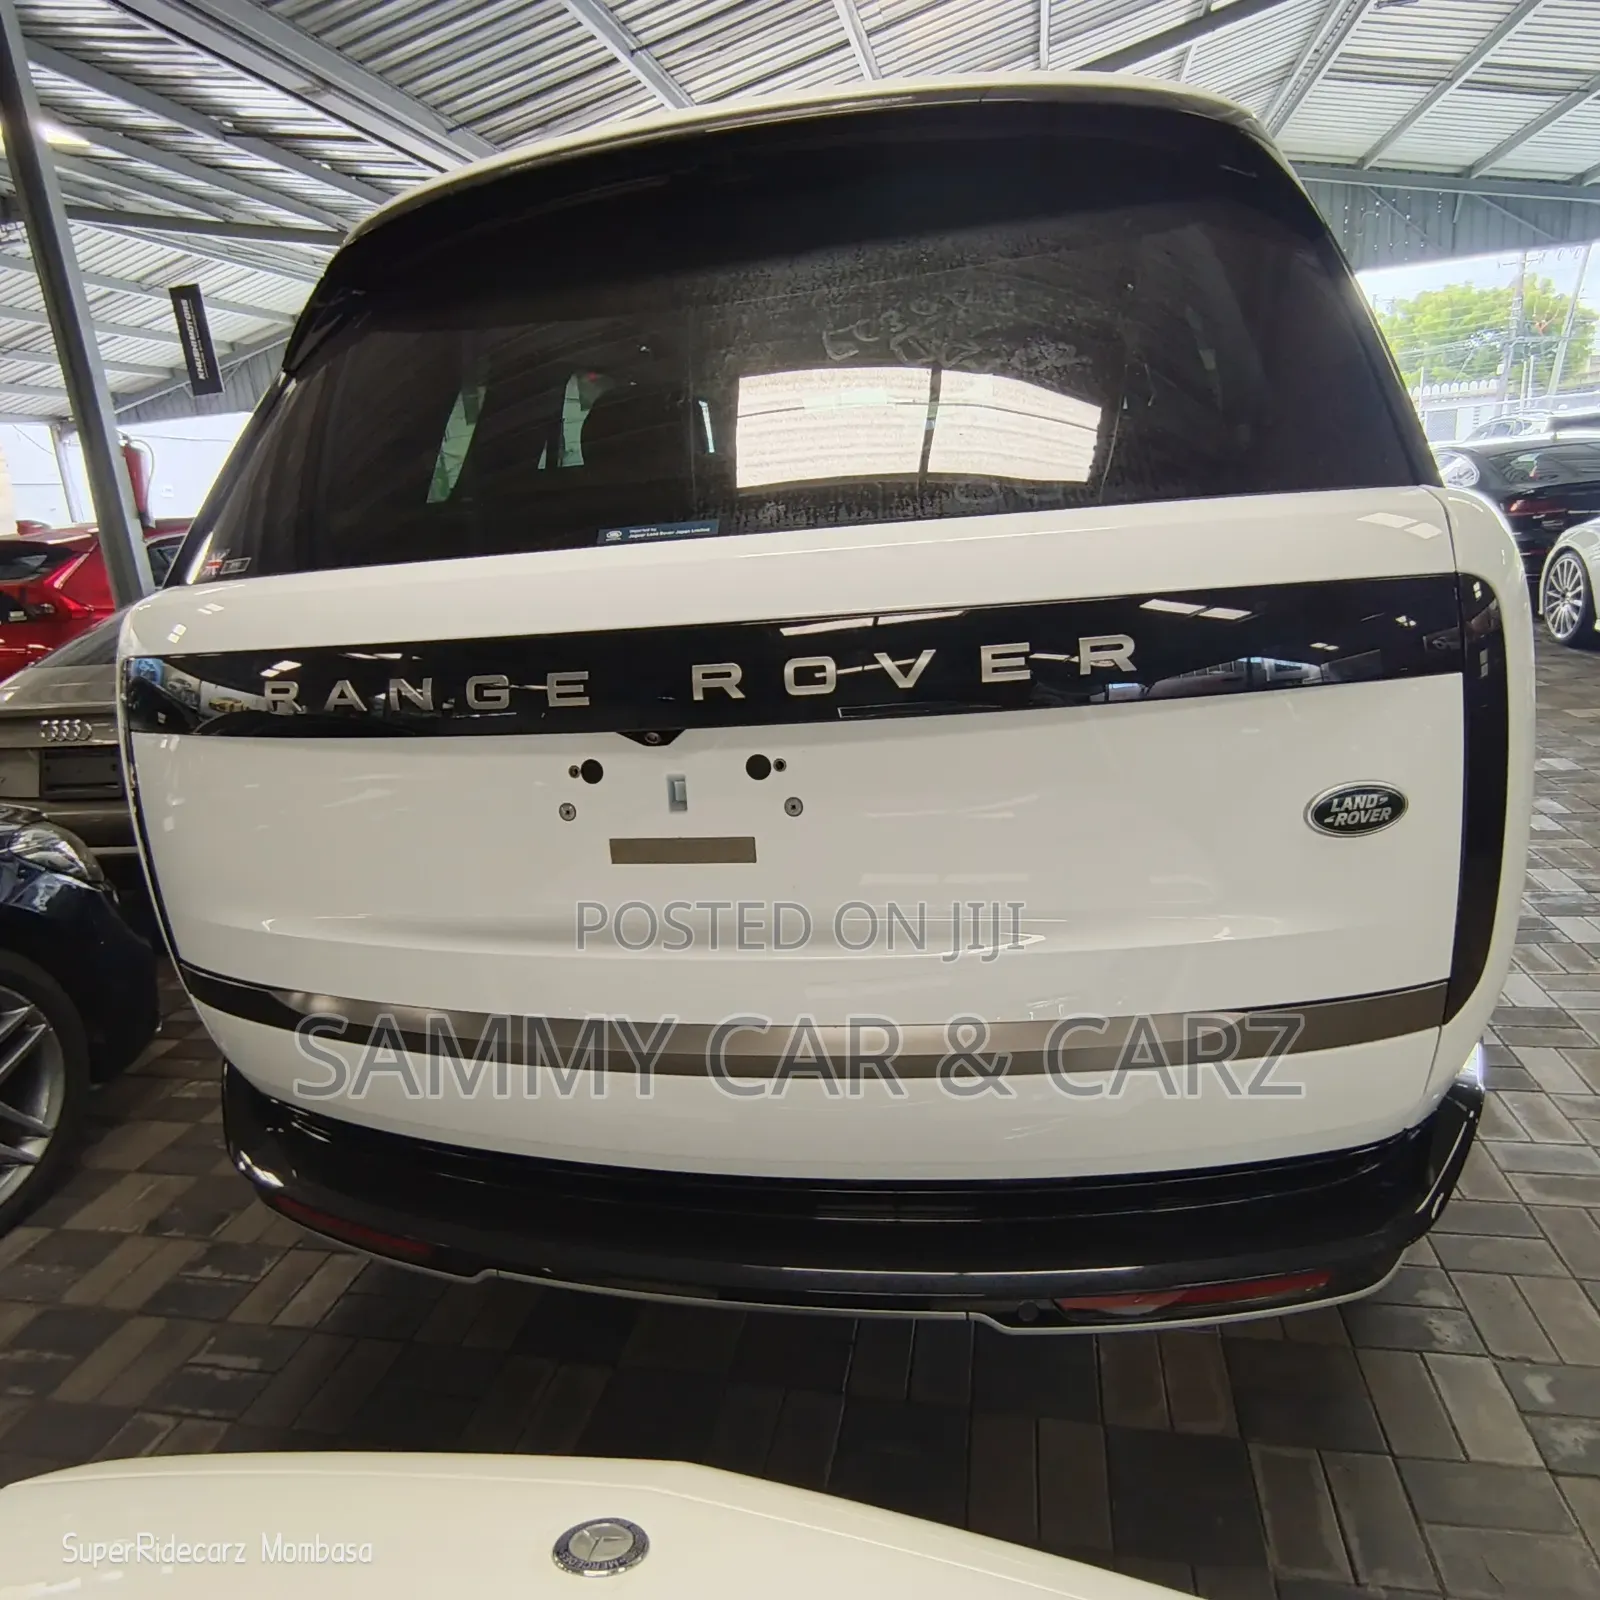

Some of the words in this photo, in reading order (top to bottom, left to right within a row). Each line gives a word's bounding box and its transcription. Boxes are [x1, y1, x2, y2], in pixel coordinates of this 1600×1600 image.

[264, 671, 590, 715] RANGE
[691, 634, 1138, 700] ROVER
[1330, 794, 1378, 813] LAND
[1333, 807, 1392, 827] ROVER
